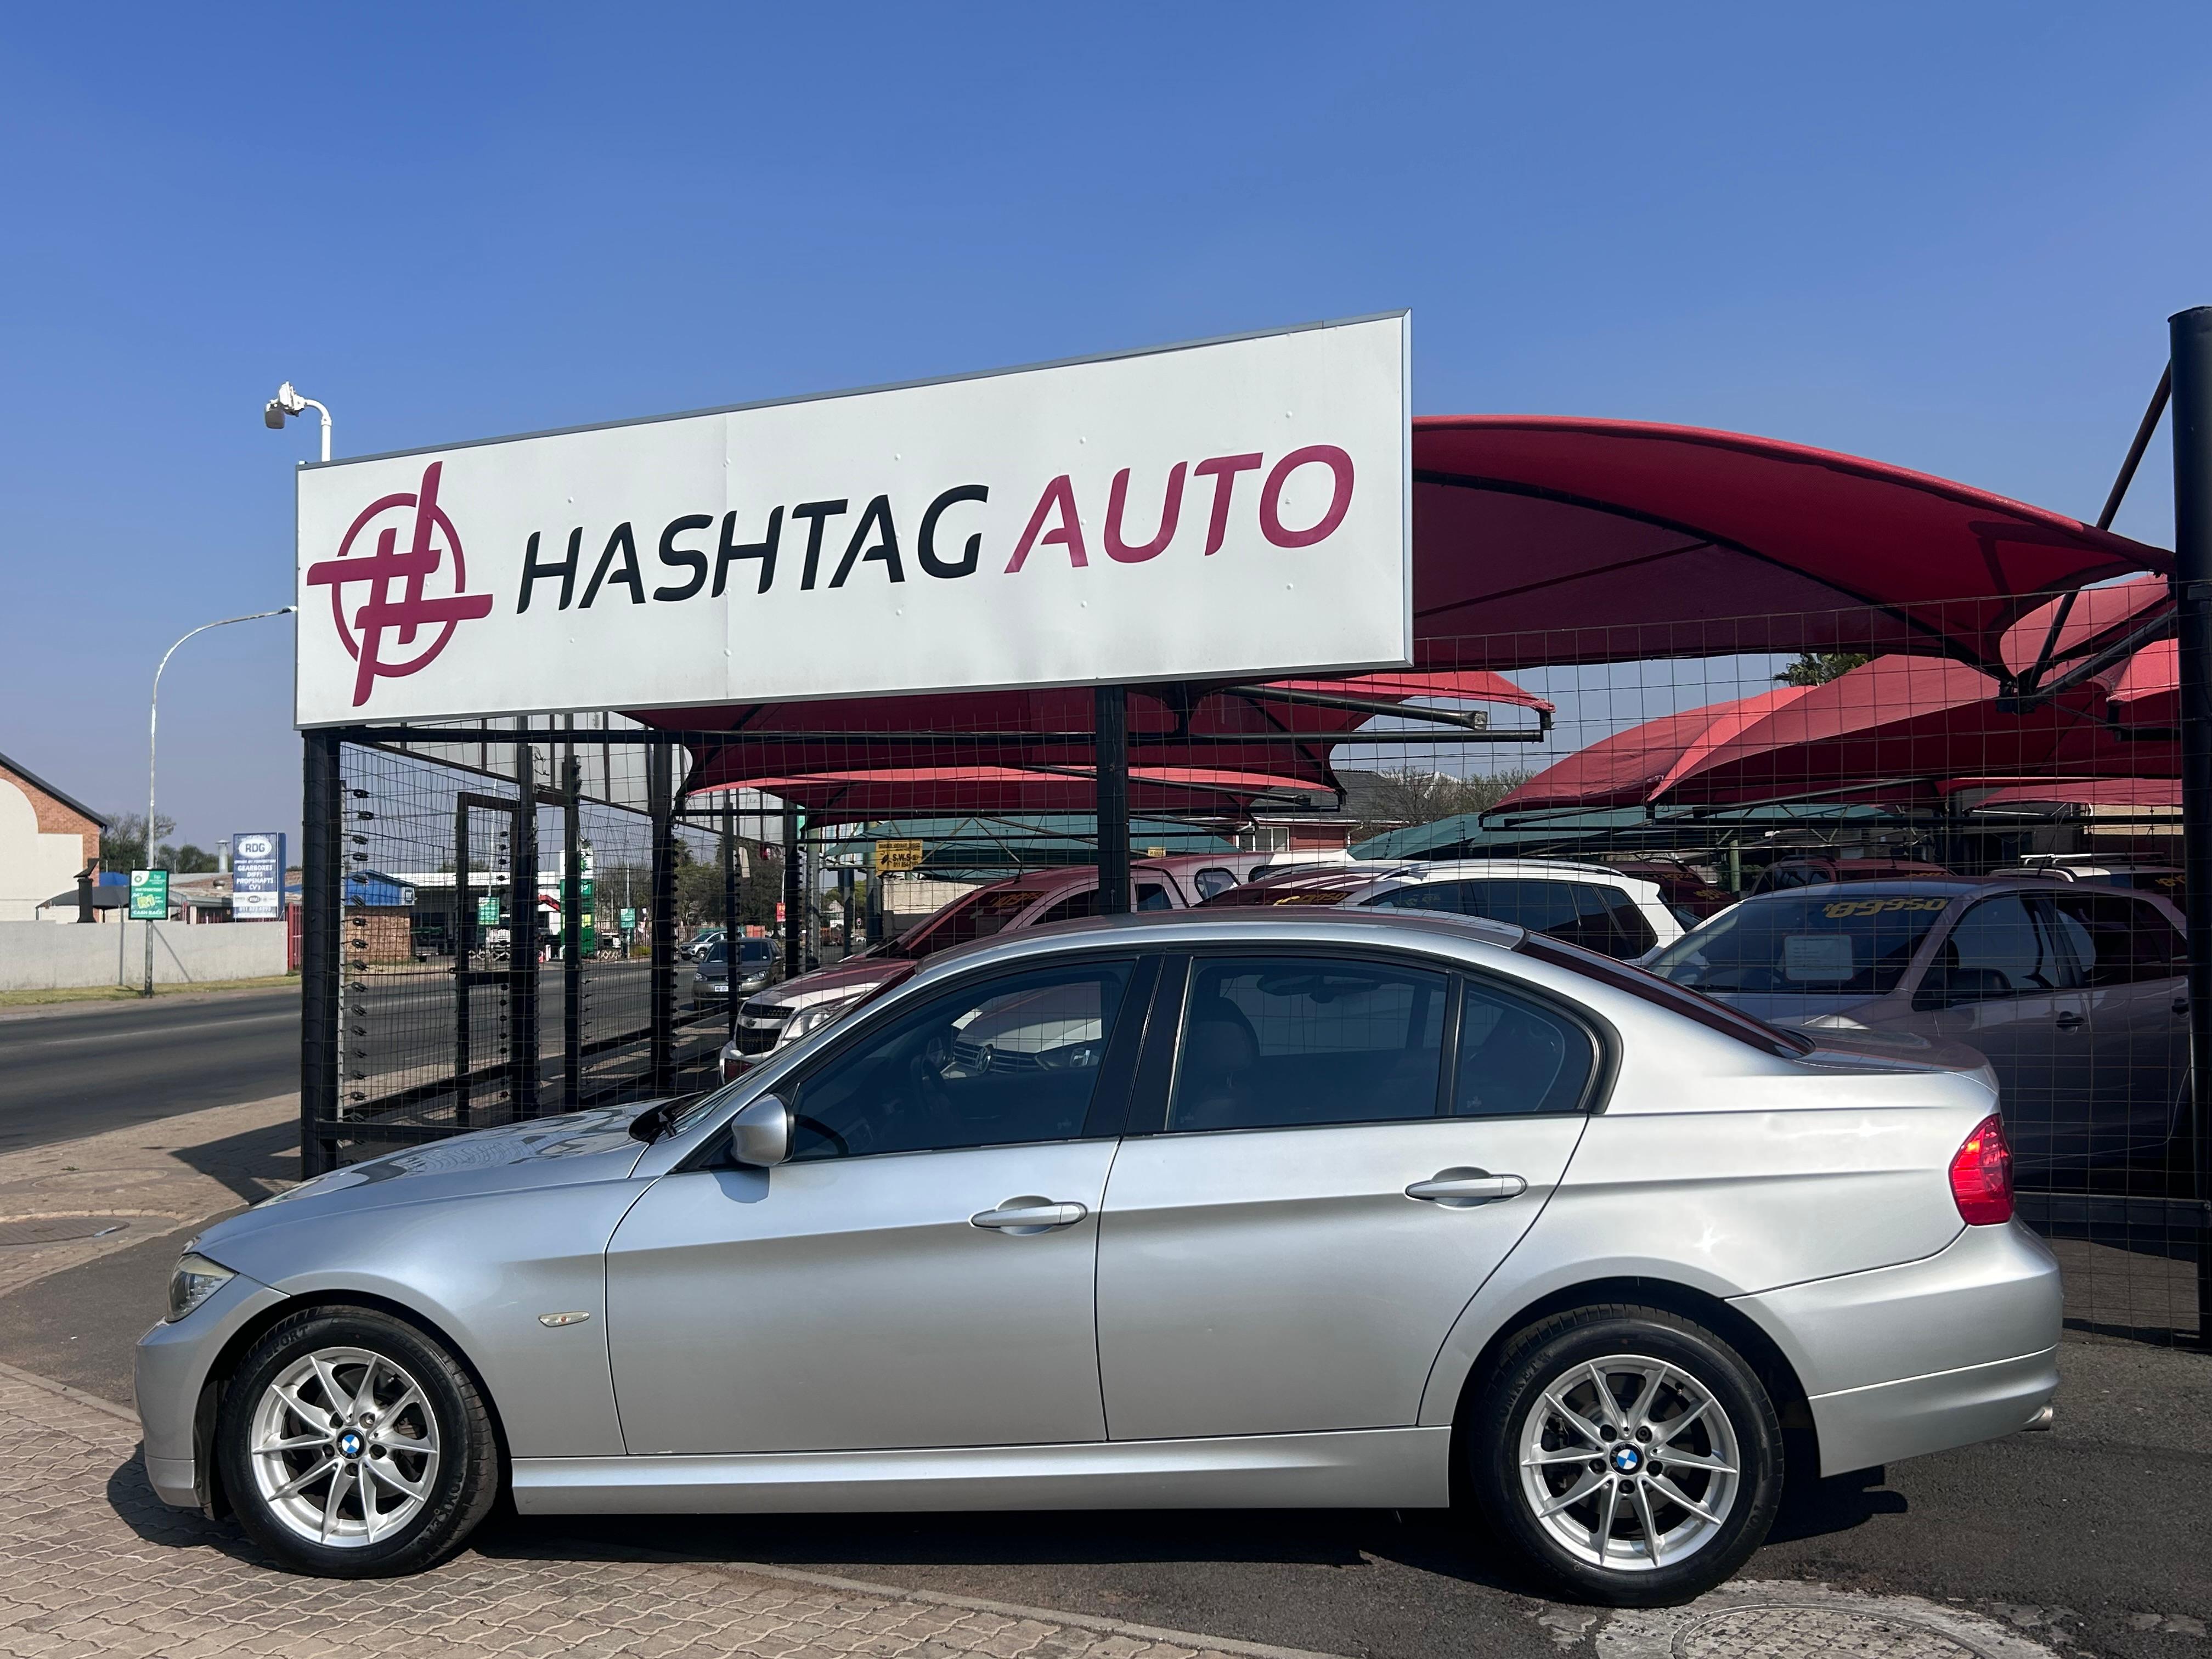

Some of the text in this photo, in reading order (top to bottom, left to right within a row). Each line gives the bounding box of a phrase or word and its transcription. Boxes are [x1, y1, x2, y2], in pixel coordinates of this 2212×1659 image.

[517, 445, 1355, 614] HASHTAG AUTO
[245, 843, 266, 853] RDG
